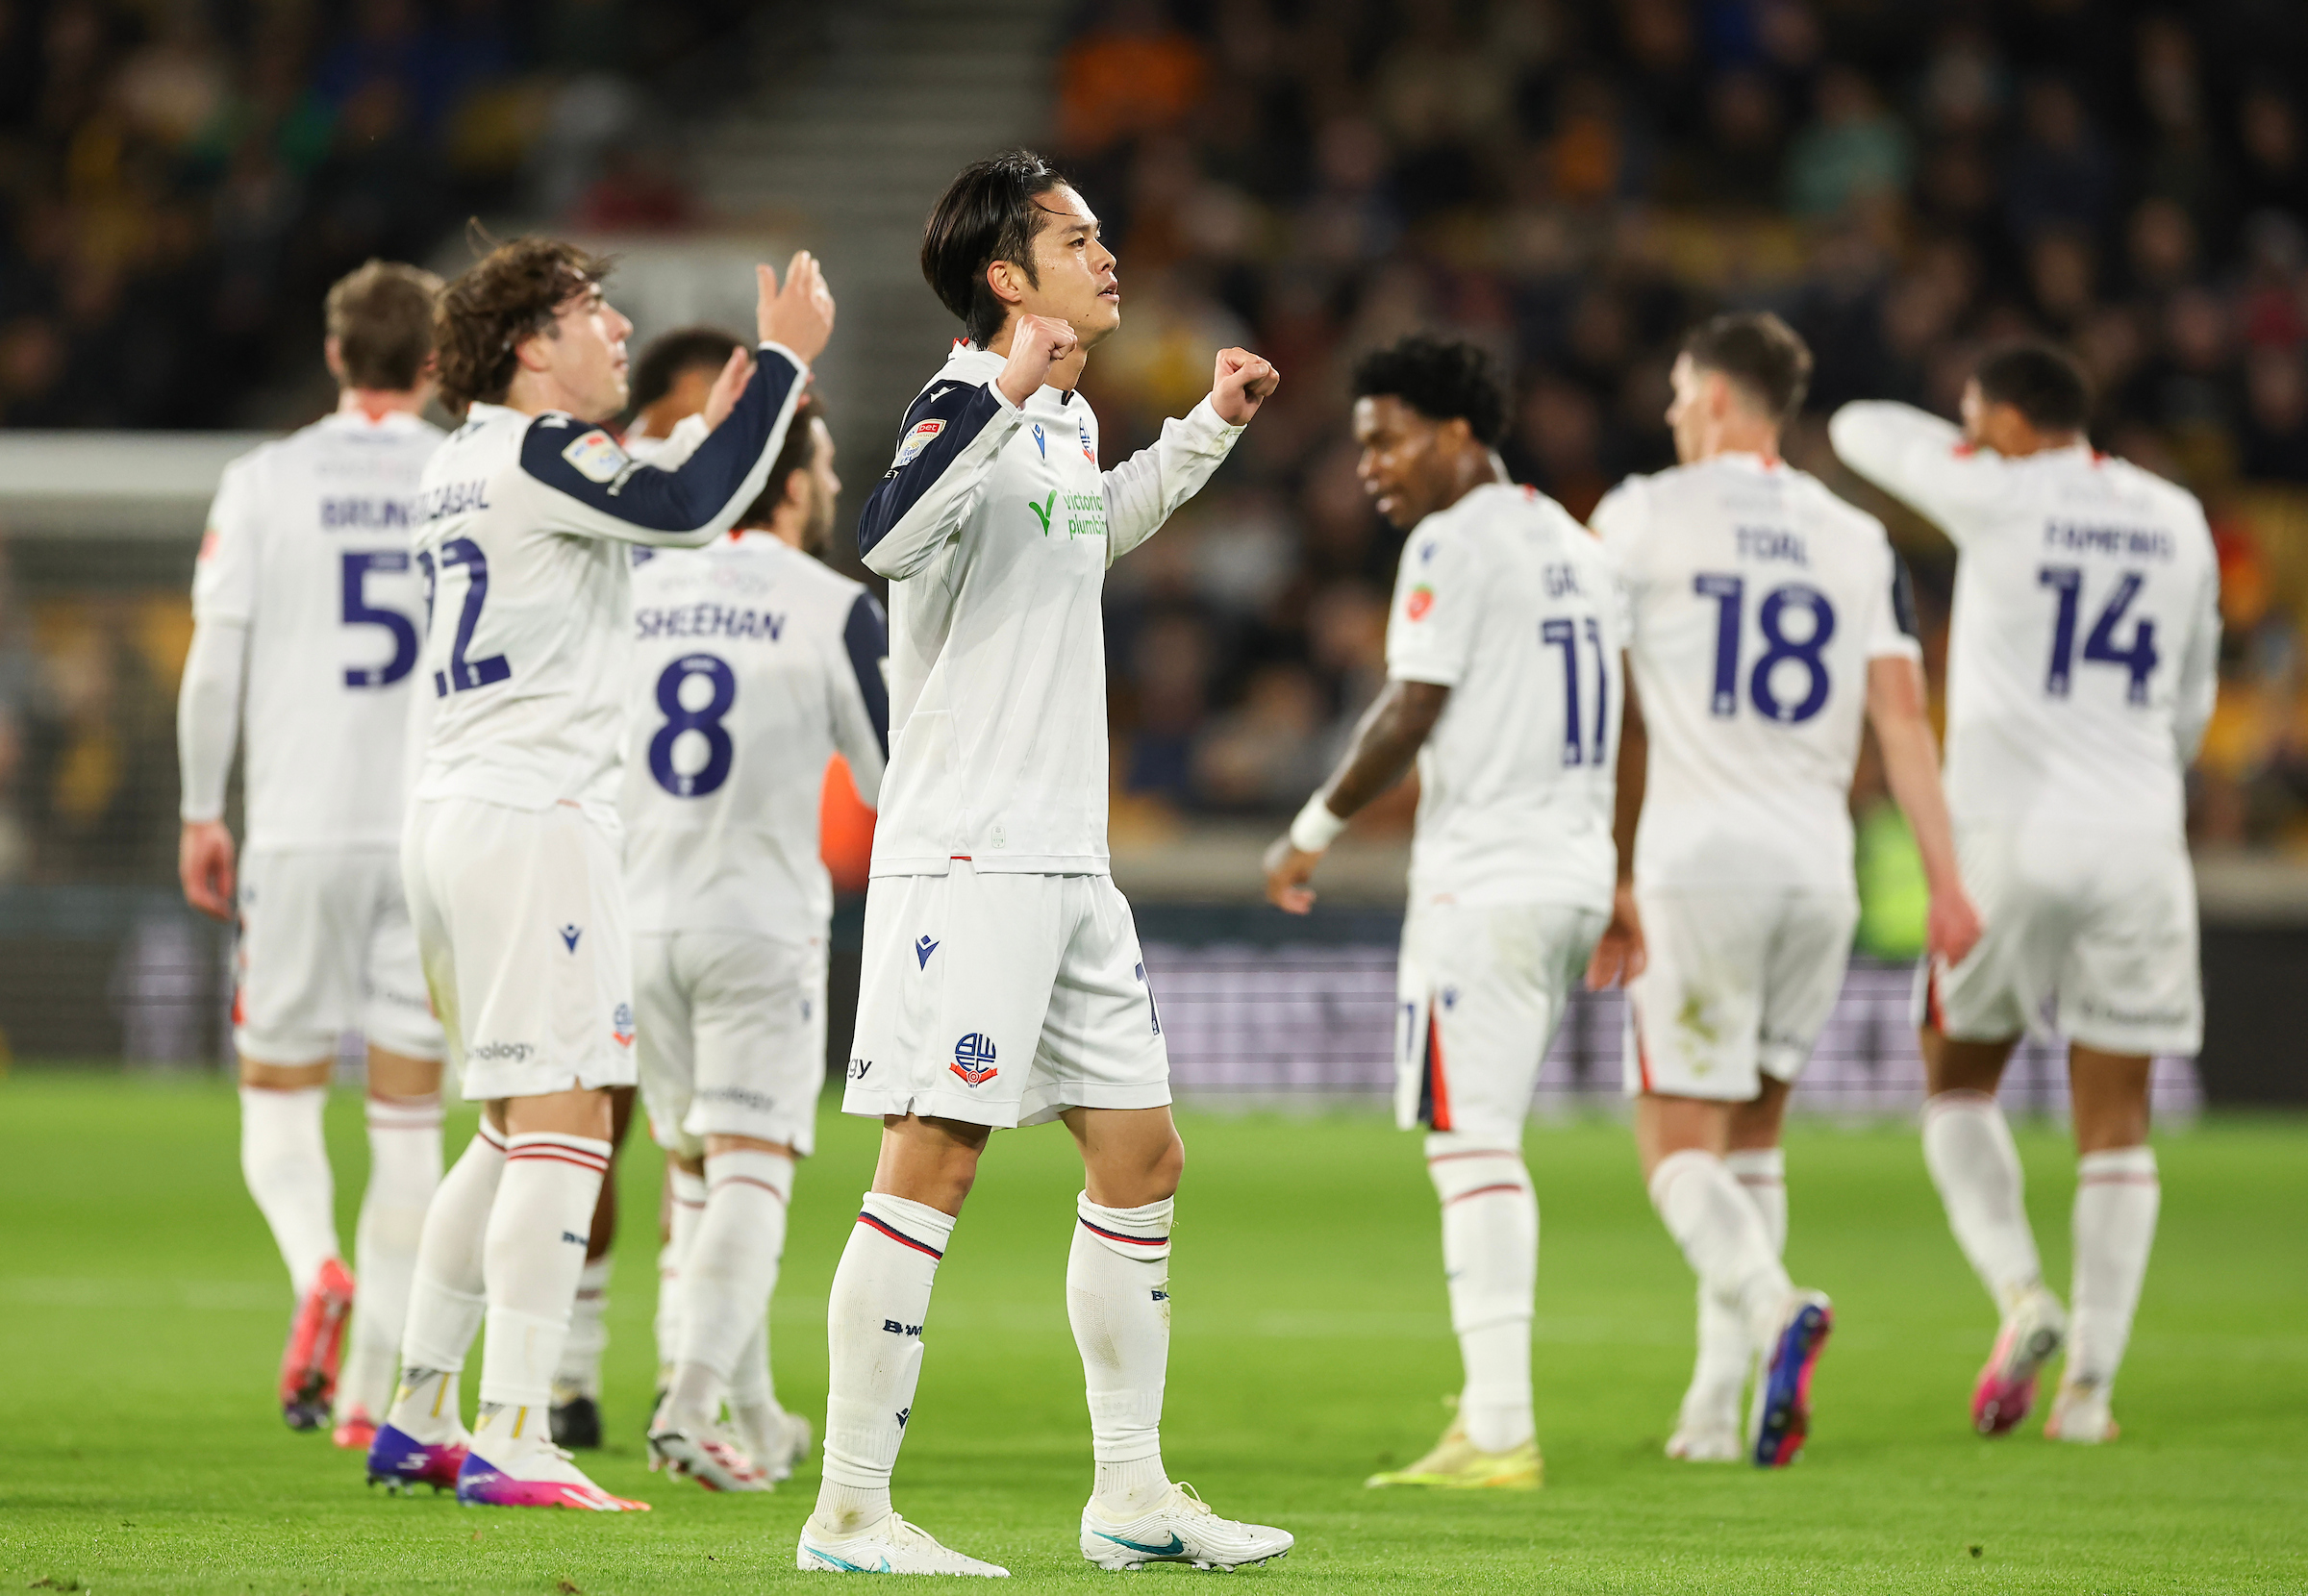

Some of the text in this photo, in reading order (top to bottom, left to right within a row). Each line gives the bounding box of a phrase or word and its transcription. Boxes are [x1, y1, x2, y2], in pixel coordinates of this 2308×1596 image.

[342, 552, 418, 686] 5
[635, 602, 786, 642] SHEEHAN
[1694, 573, 1834, 723] 18
[2039, 568, 2157, 707] 14
[648, 654, 737, 797] 8
[1543, 617, 1606, 765] 11
